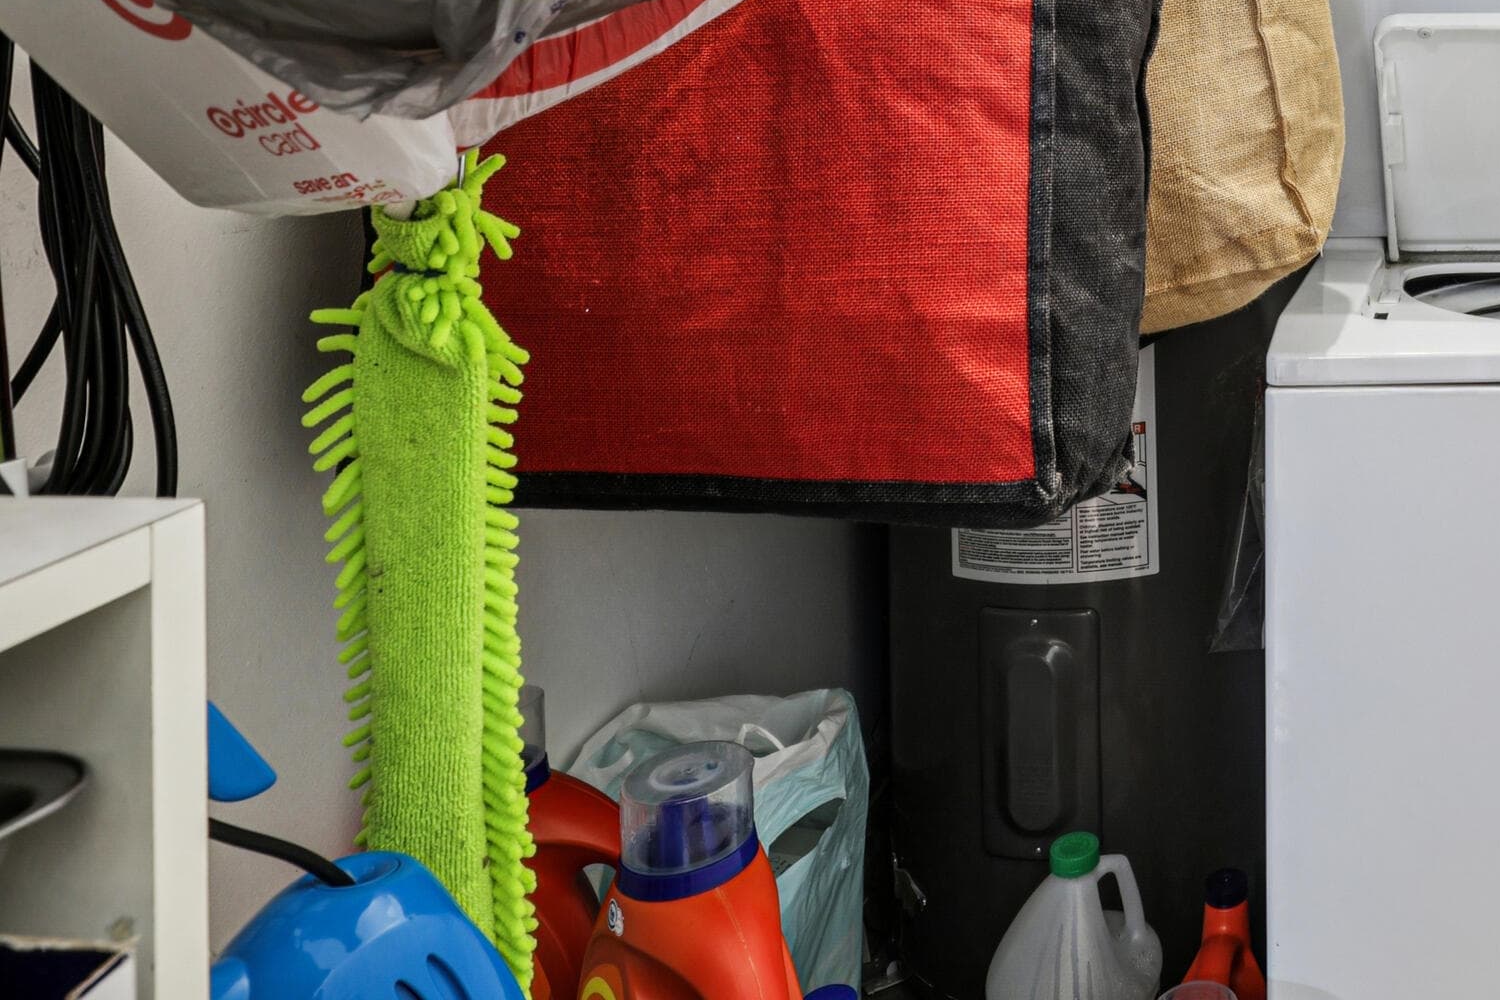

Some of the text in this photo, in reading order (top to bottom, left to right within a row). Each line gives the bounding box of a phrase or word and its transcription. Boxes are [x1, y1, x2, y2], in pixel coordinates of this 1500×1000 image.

[232, 89, 320, 130] circle
[258, 122, 321, 156] card
[293, 178, 333, 195] save
[330, 172, 360, 189] an
